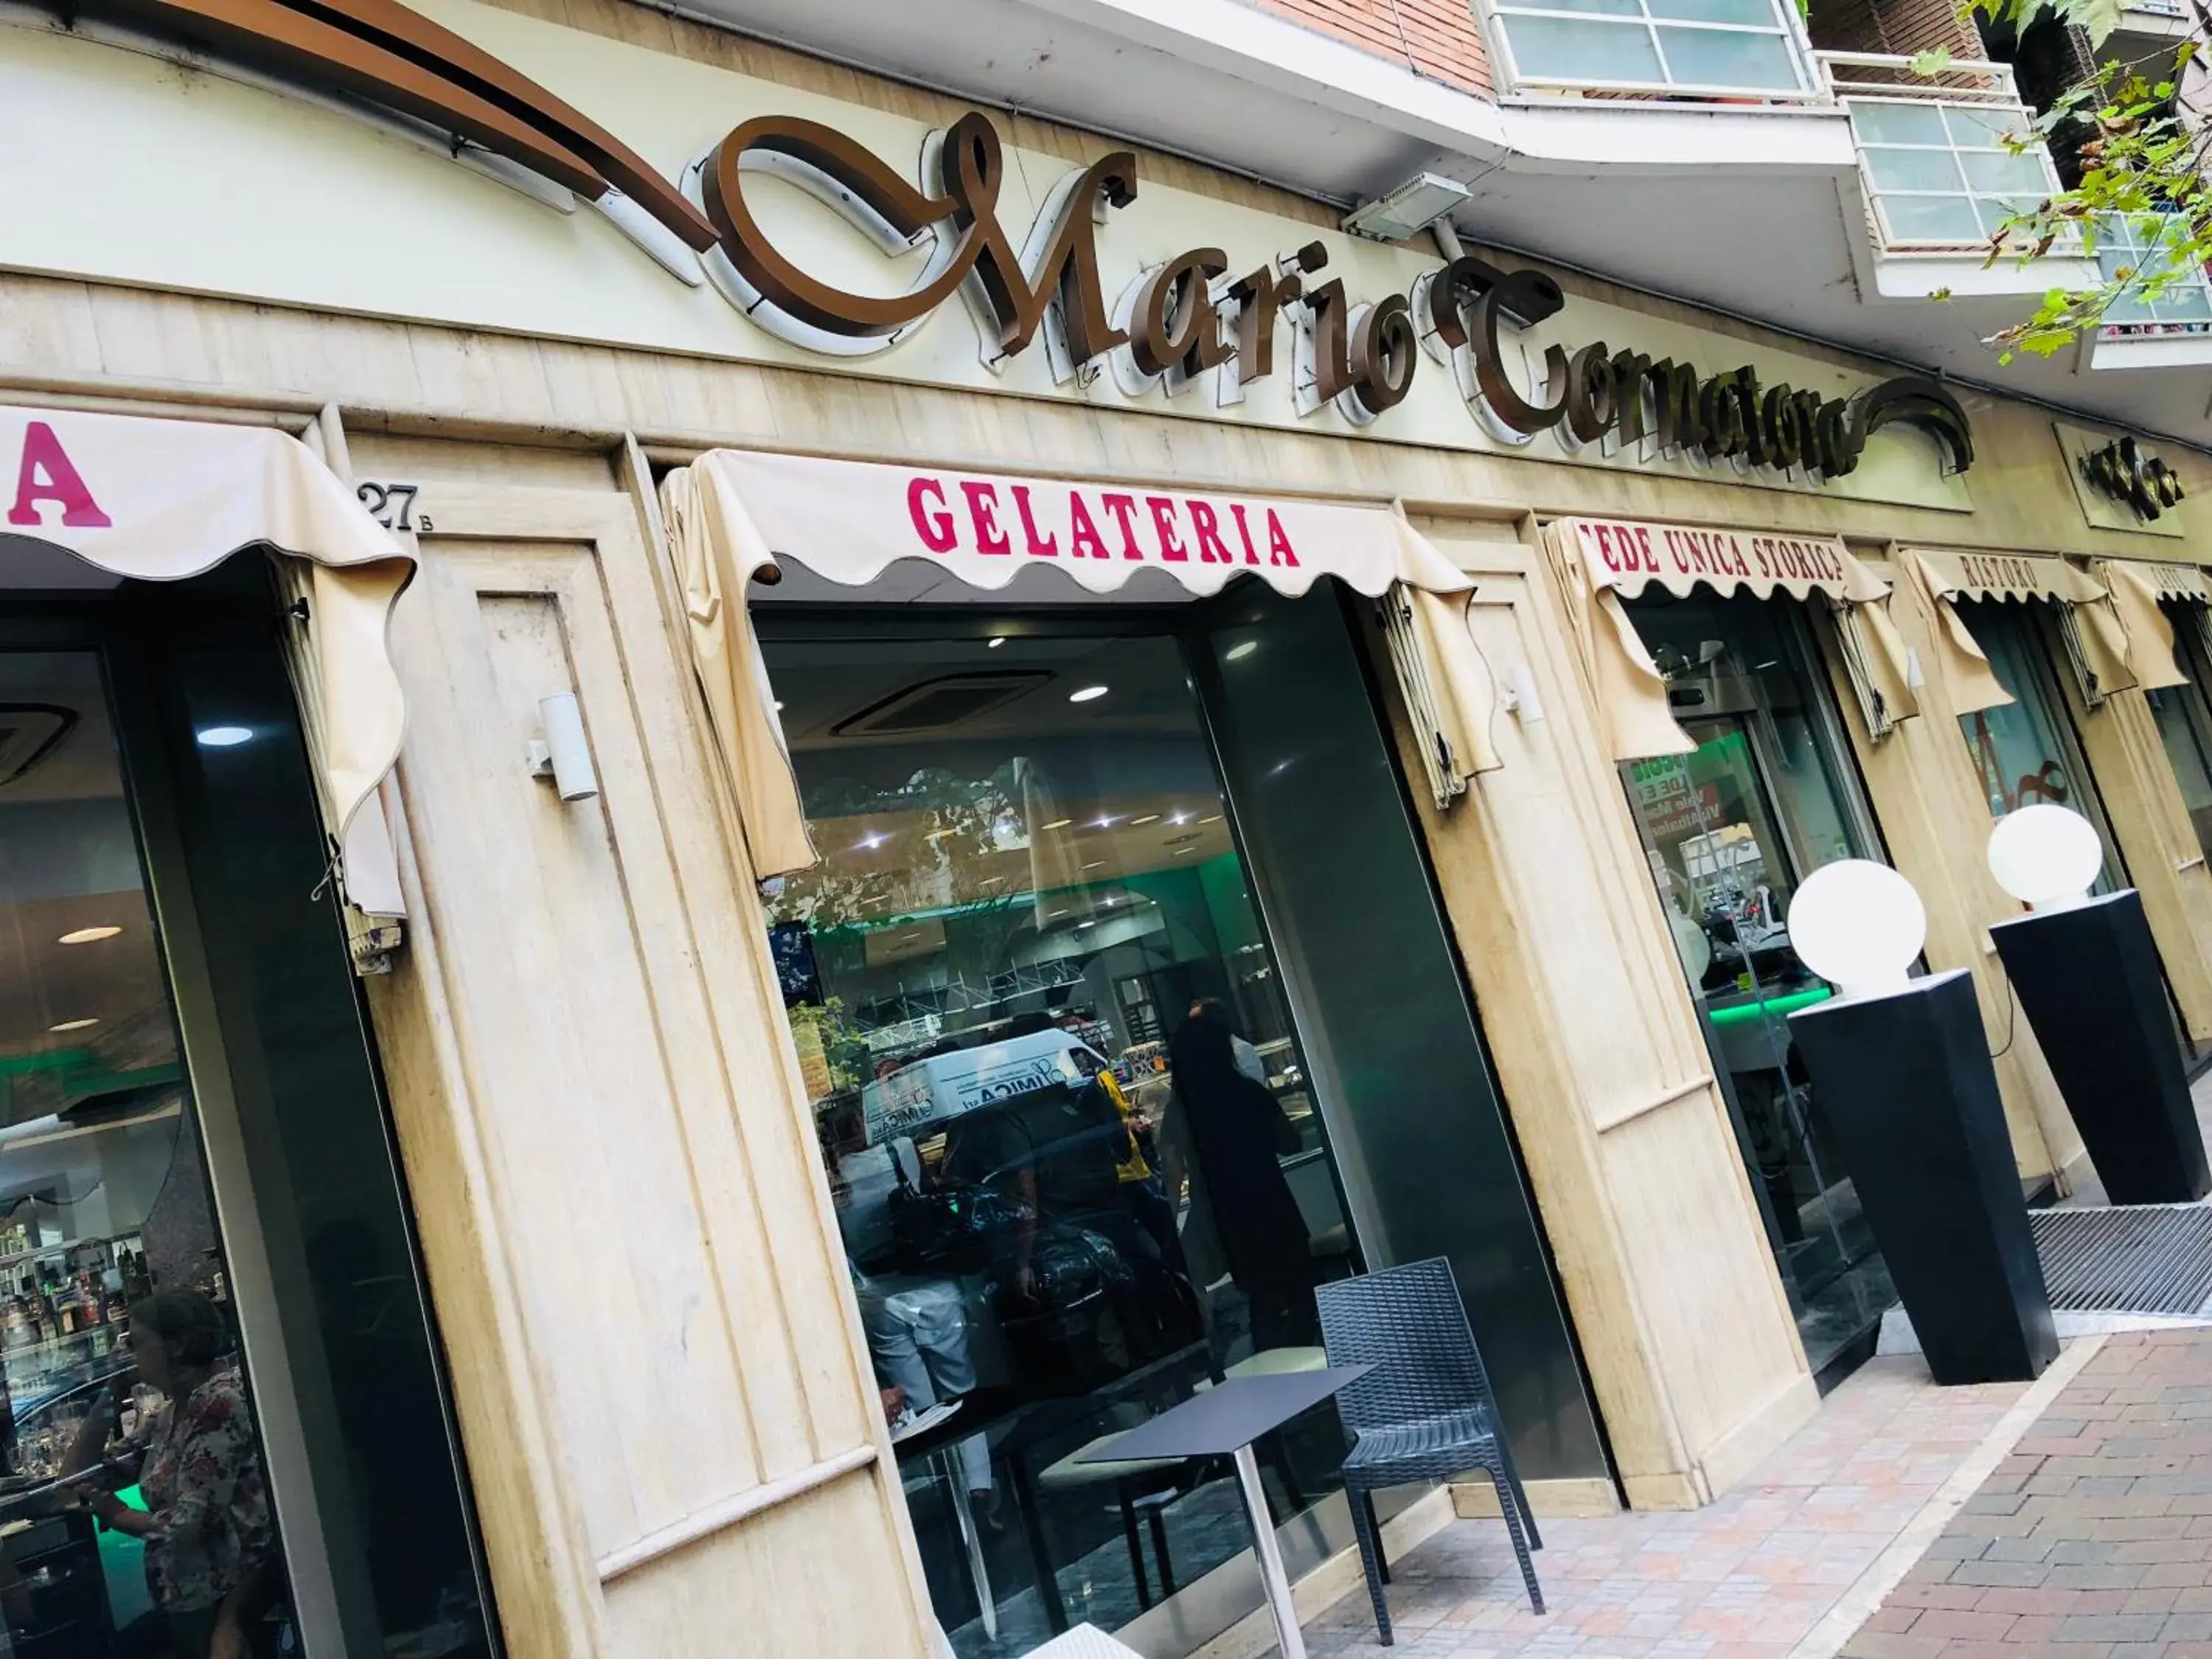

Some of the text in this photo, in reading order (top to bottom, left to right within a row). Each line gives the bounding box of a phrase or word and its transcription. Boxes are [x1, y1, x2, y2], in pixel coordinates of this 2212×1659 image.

[703, 112, 1416, 414] Mario
[7, 421, 112, 527] A
[908, 477, 1299, 567] GELATERIA
[1580, 524, 1660, 573] EDE
[1663, 529, 1750, 577] UNICA
[1958, 555, 2038, 588] RISTORO
